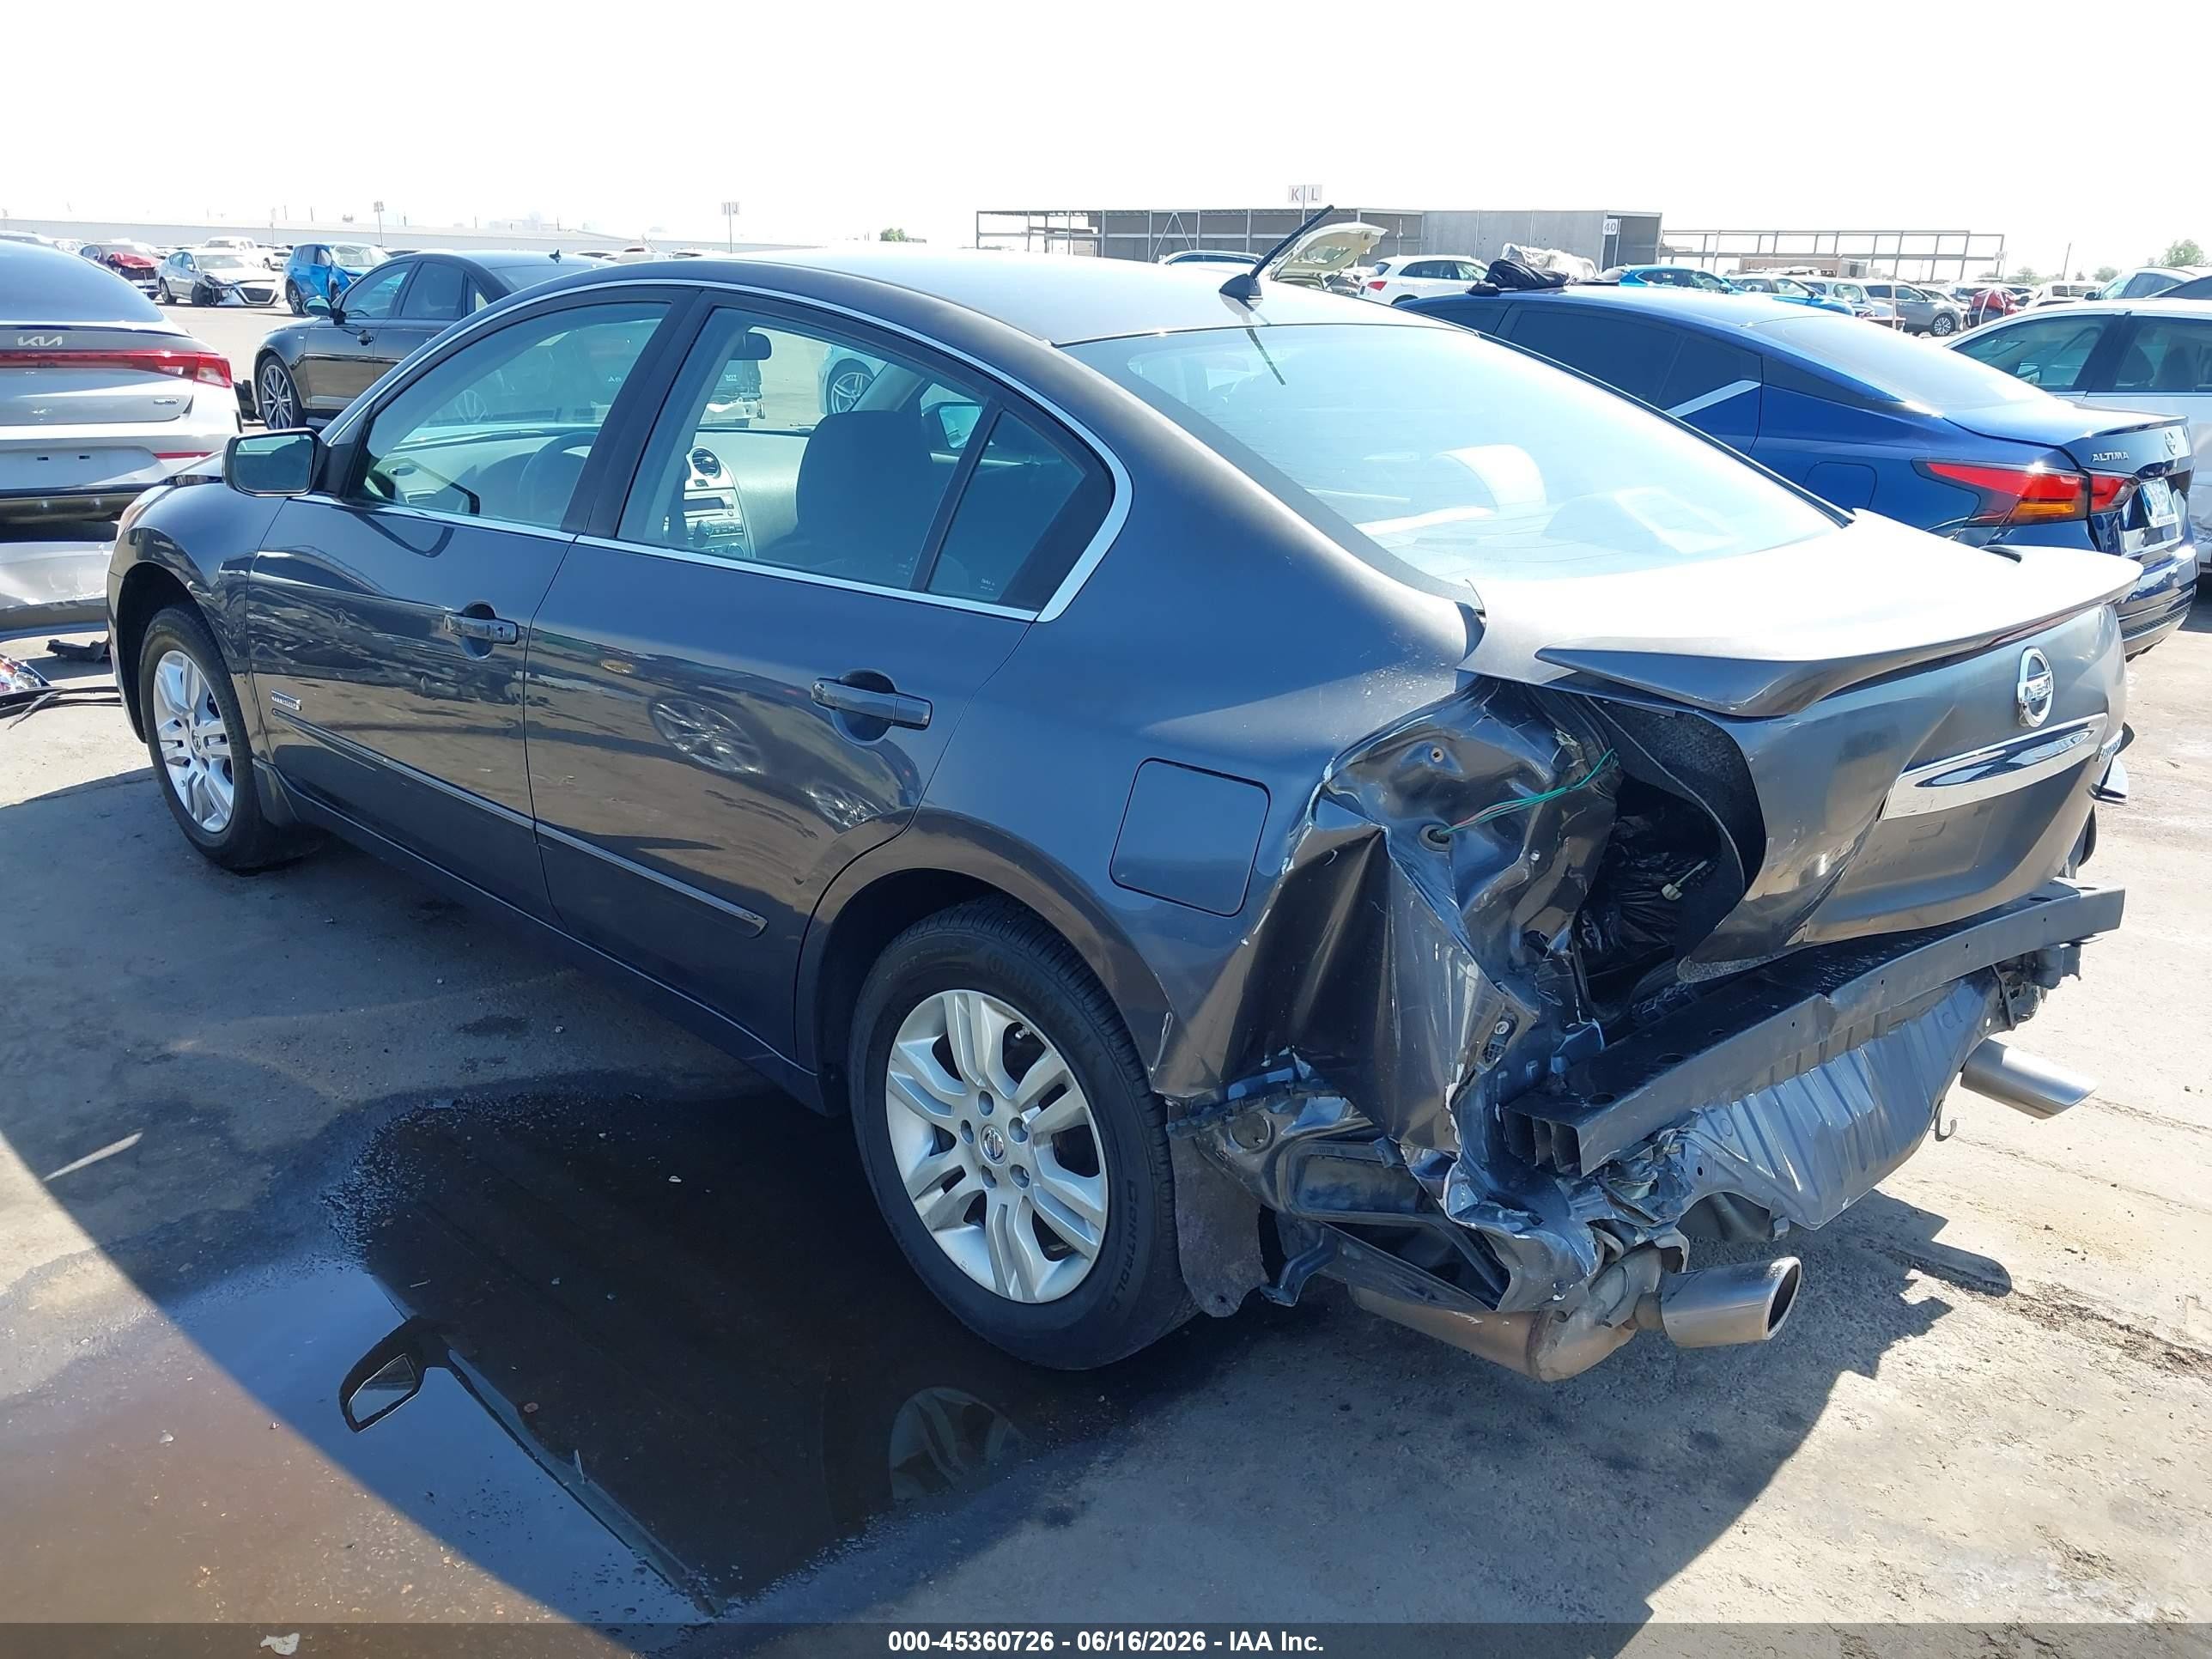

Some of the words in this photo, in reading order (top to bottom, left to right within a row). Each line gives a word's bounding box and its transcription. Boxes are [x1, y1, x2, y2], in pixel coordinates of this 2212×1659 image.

[1291, 188, 1299, 201] K
[1311, 188, 1318, 201] L
[1604, 222, 1616, 232] 40
[17, 336, 63, 347] KIA
[2091, 452, 2130, 462] ALTIMA
